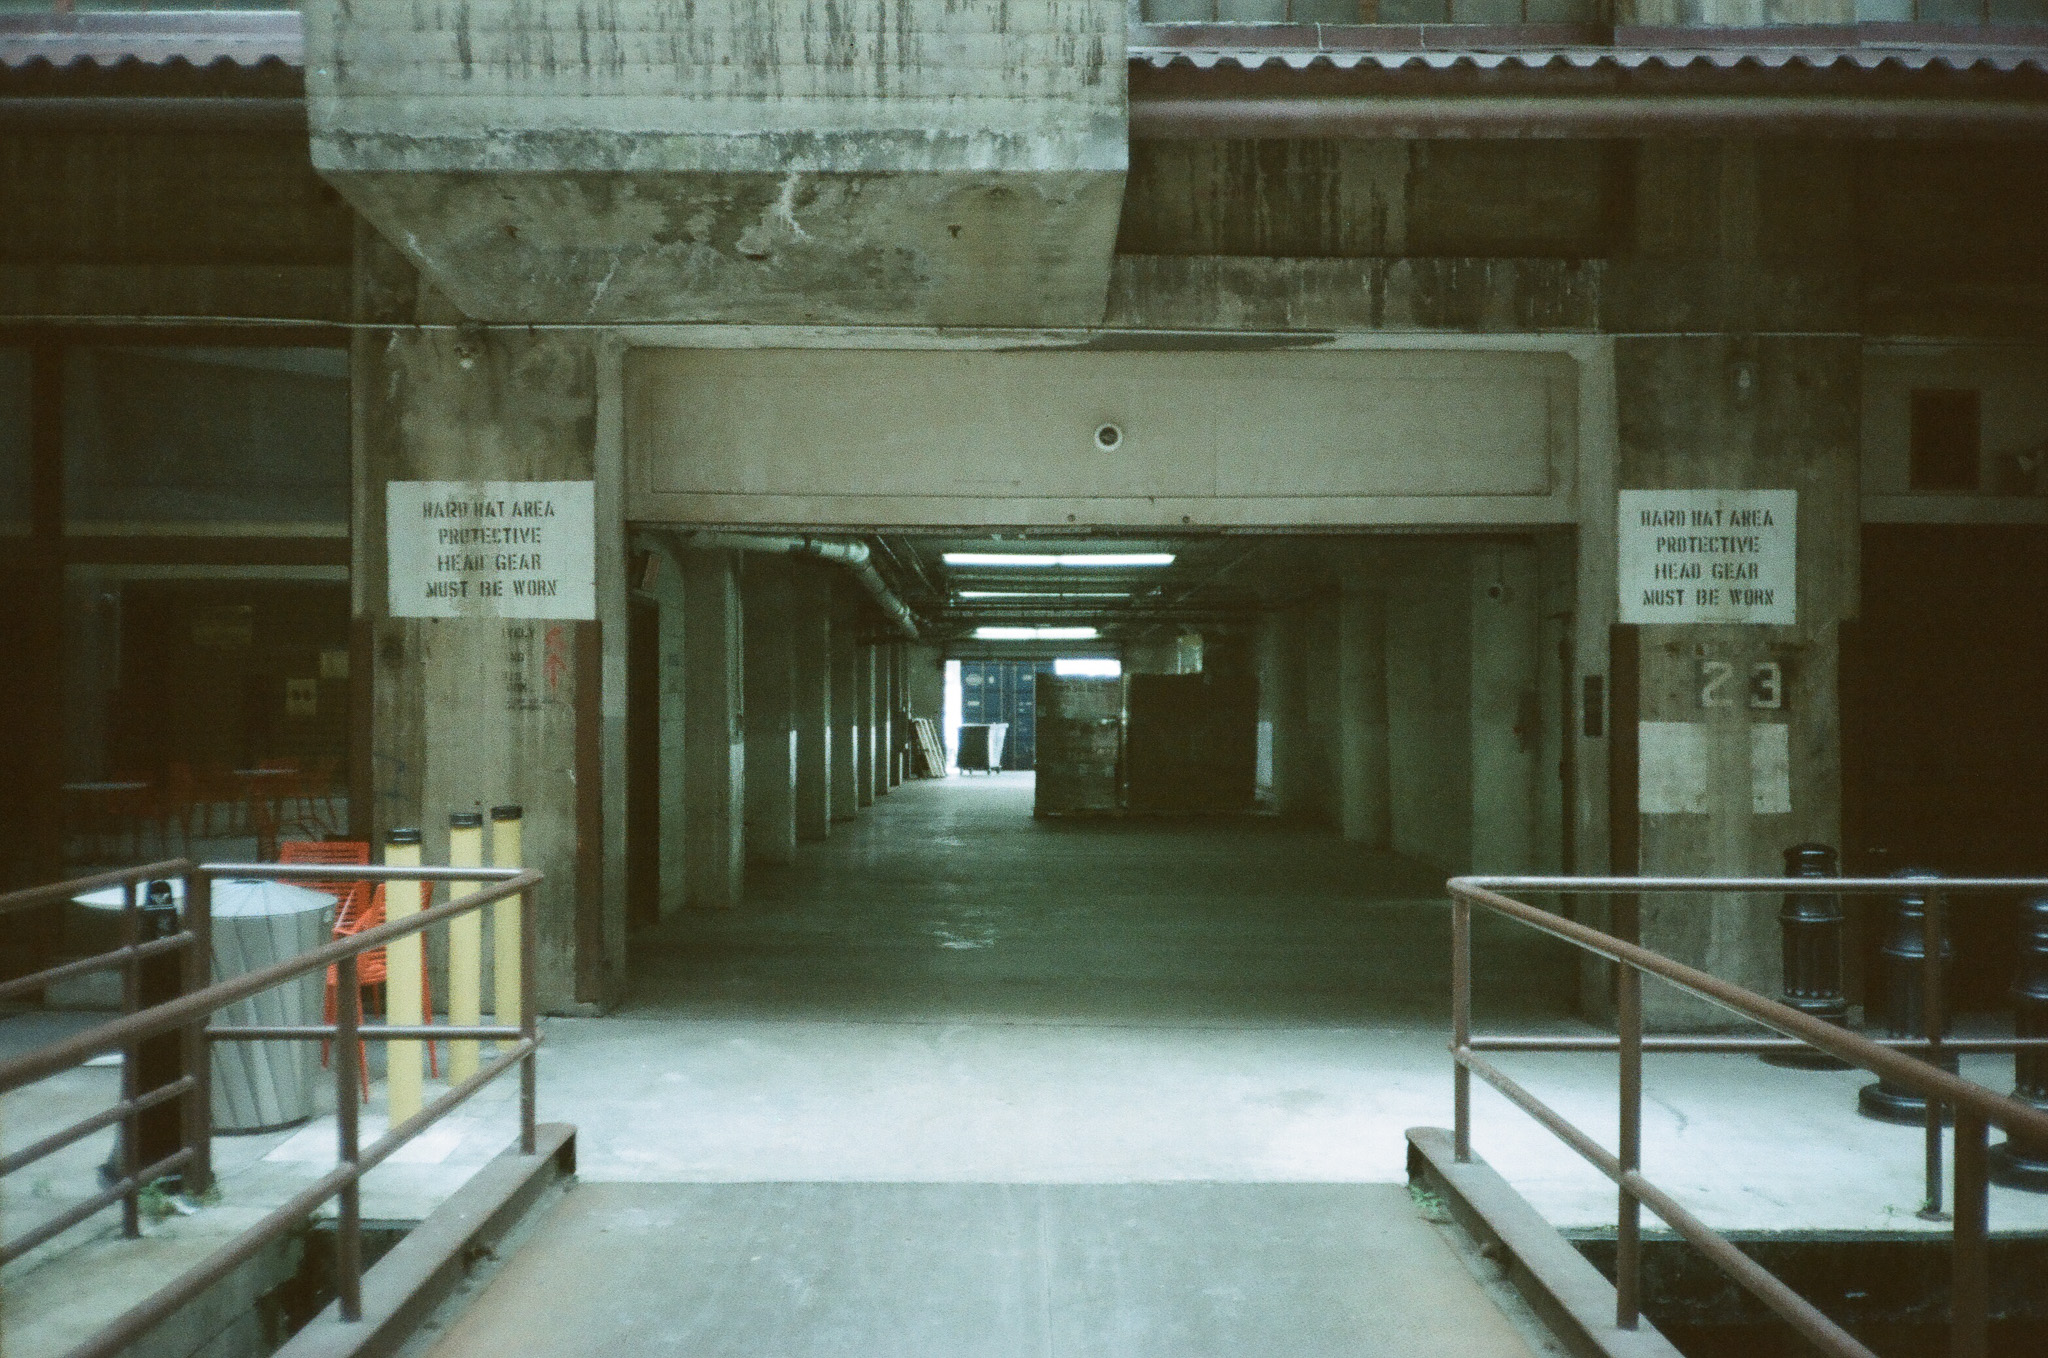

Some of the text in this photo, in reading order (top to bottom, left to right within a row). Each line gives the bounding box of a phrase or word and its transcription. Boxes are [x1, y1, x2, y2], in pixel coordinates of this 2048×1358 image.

[423, 501, 555, 518] HARD HAT AREA
[1640, 509, 1775, 527] HARD HAT AREA
[439, 527, 541, 544] PROTECTIVE
[1656, 536, 1761, 553] PROTECTIVE
[437, 554, 541, 571] HEAD GEAR
[1654, 562, 1759, 580] HEAD GEAR
[426, 580, 558, 597] MUST BE WORN
[1642, 588, 1775, 606] MUST BE WORN
